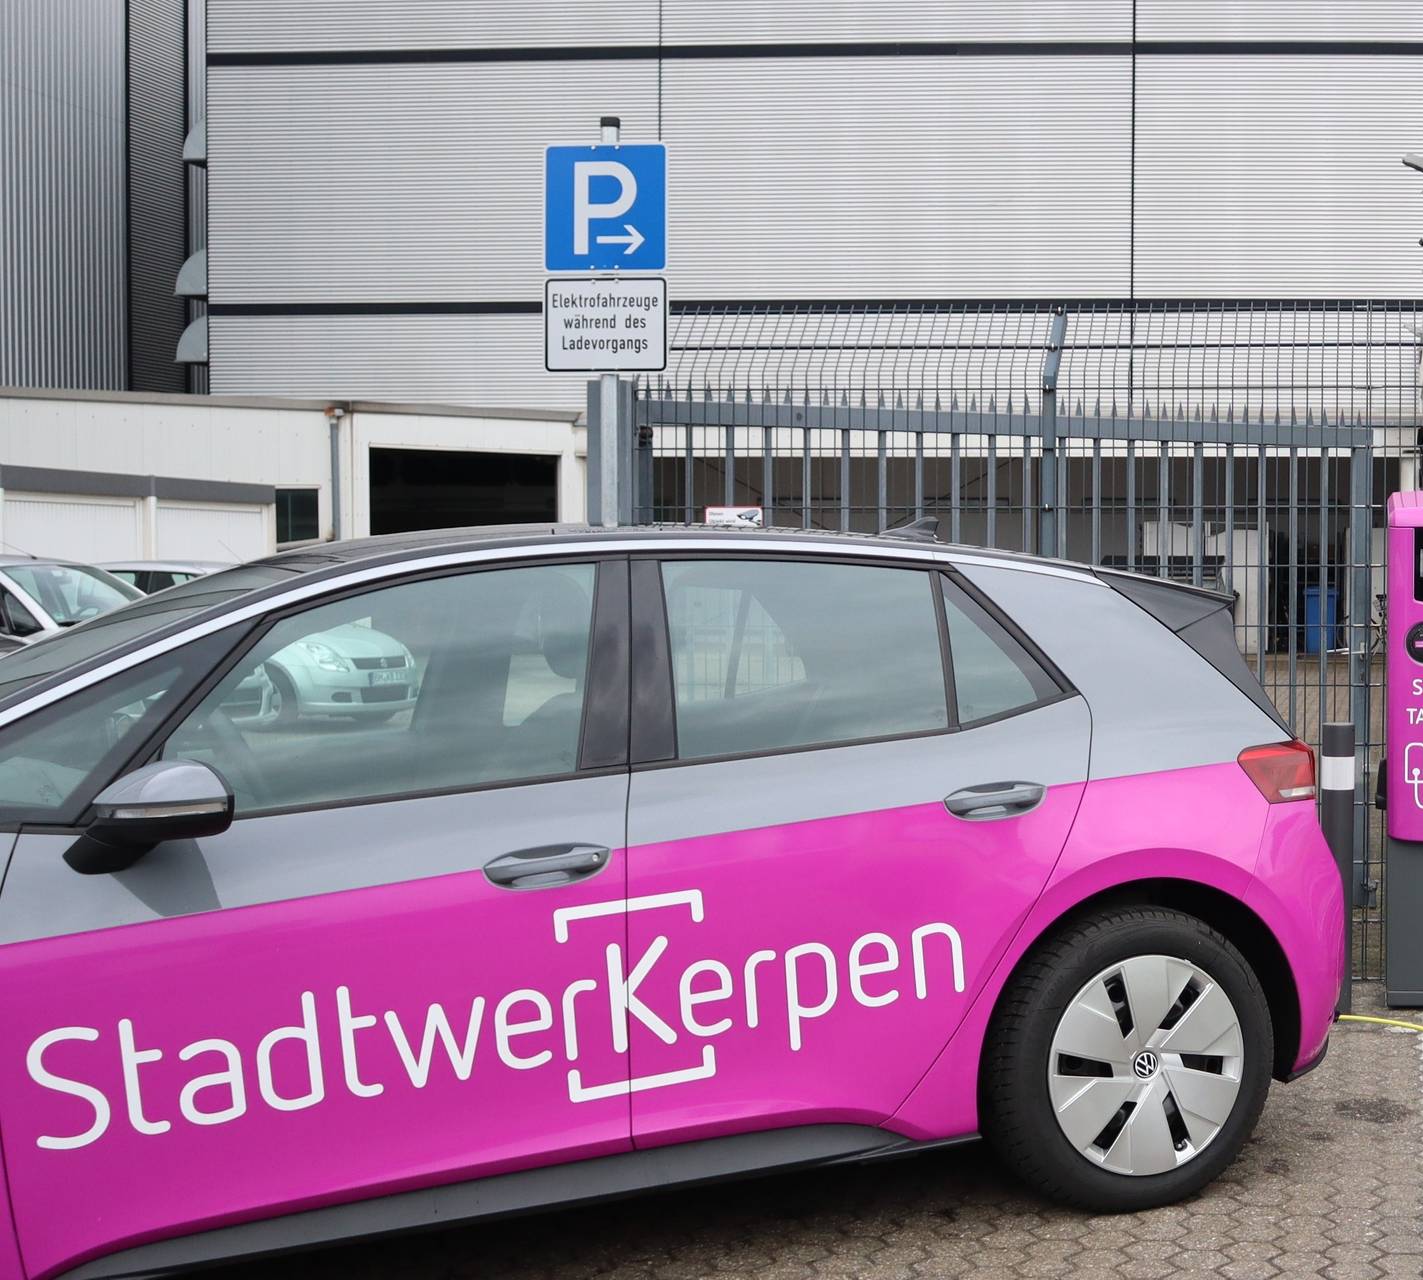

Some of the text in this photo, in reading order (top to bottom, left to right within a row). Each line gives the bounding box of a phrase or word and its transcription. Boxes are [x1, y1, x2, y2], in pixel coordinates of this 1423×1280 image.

[573, 161, 637, 255] P
[551, 293, 658, 312] Elektrofahrzeuge
[563, 313, 646, 329] während des
[561, 335, 648, 353] Ladevorgangs
[26, 922, 966, 1150] StadtwerKerpen
